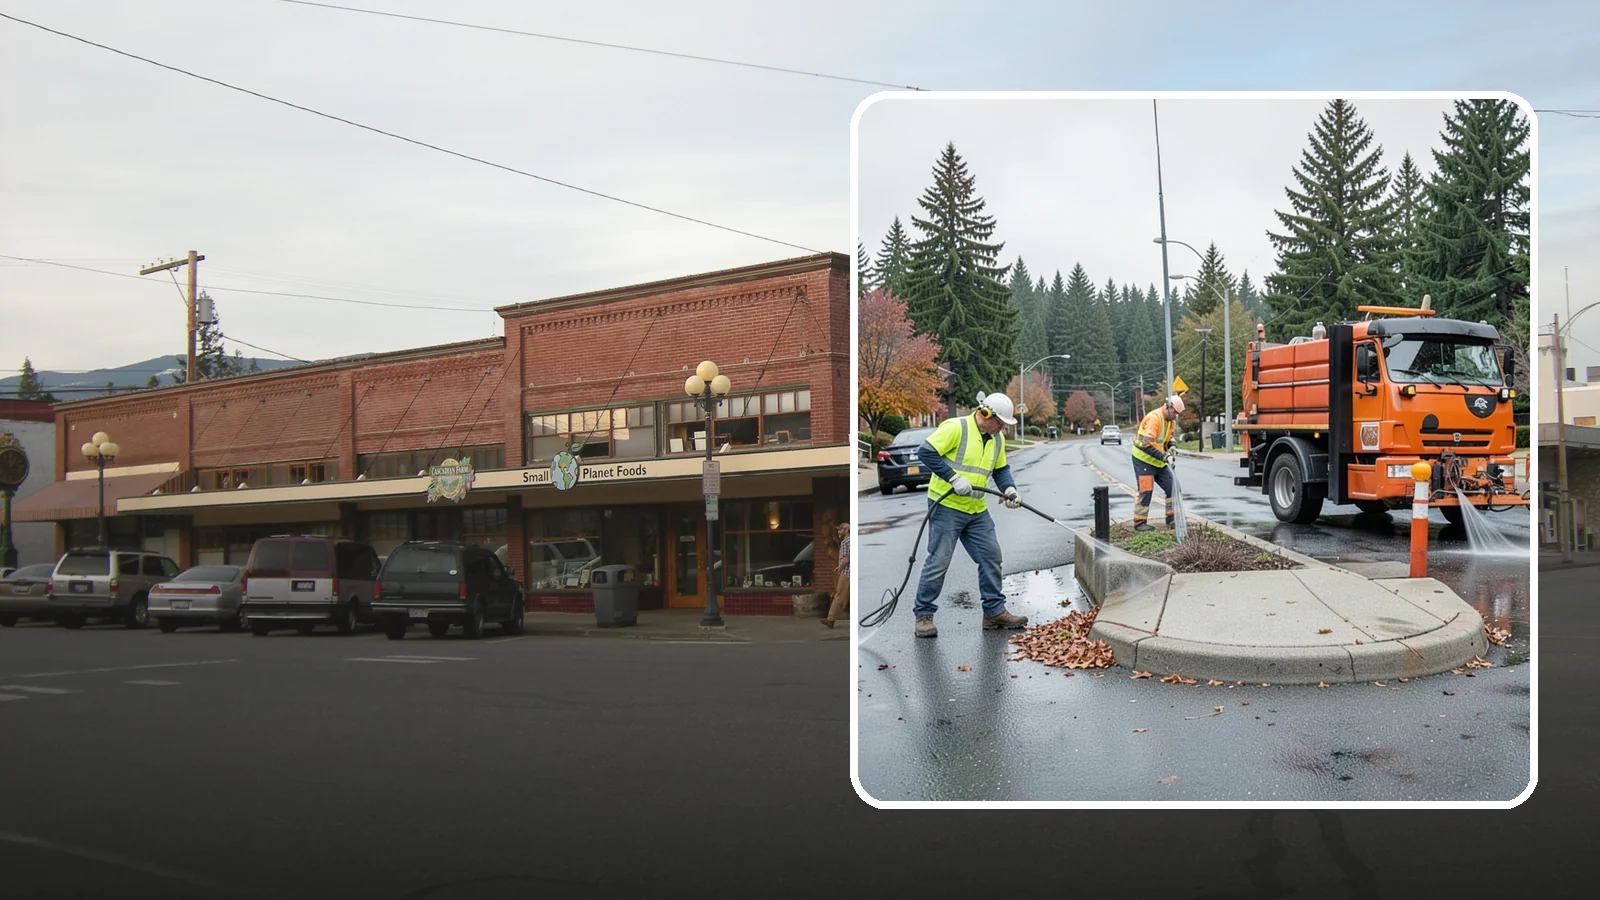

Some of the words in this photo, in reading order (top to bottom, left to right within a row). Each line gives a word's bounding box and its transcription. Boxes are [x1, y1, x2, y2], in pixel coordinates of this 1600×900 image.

[523, 471, 548, 483] Small
[583, 468, 613, 479] Planet
[617, 464, 646, 477] Foods
